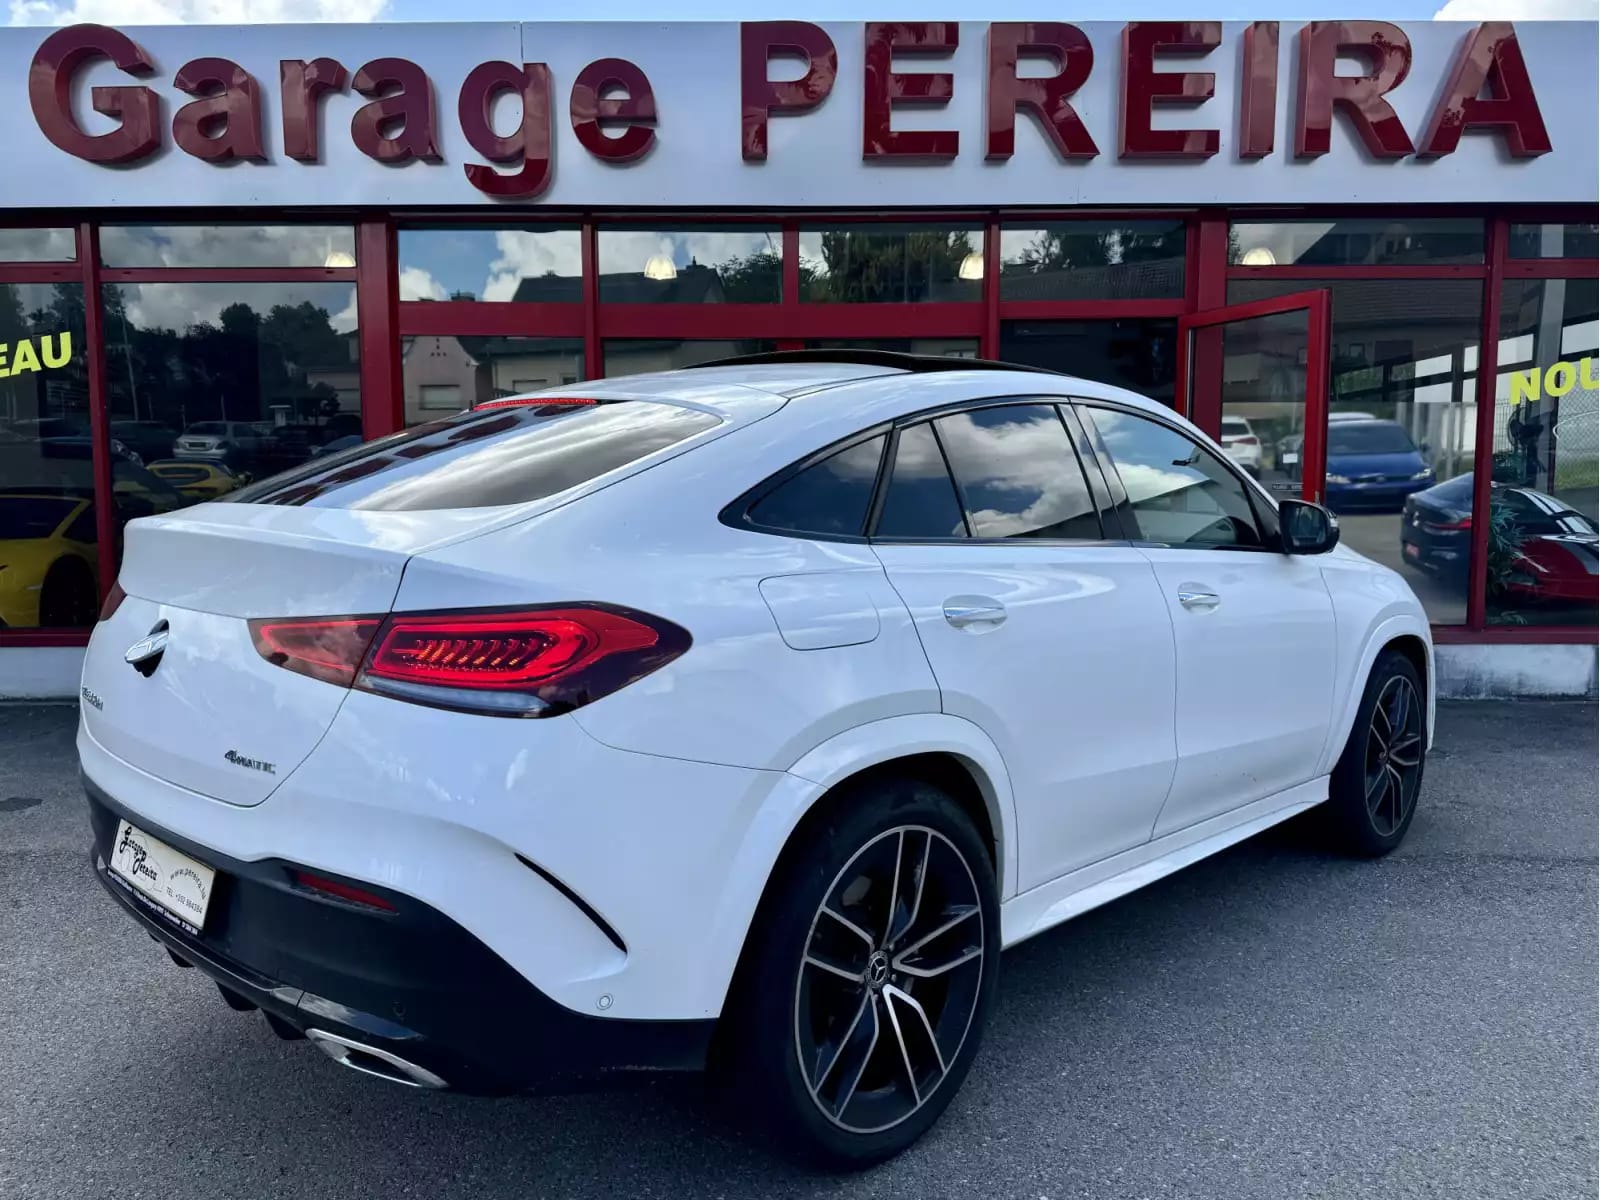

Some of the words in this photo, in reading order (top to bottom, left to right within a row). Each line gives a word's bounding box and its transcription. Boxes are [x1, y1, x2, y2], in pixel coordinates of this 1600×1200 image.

[28, 23, 658, 199] Garage
[740, 21, 1553, 161] PEREIRA
[224, 750, 276, 775] 4MATIC
